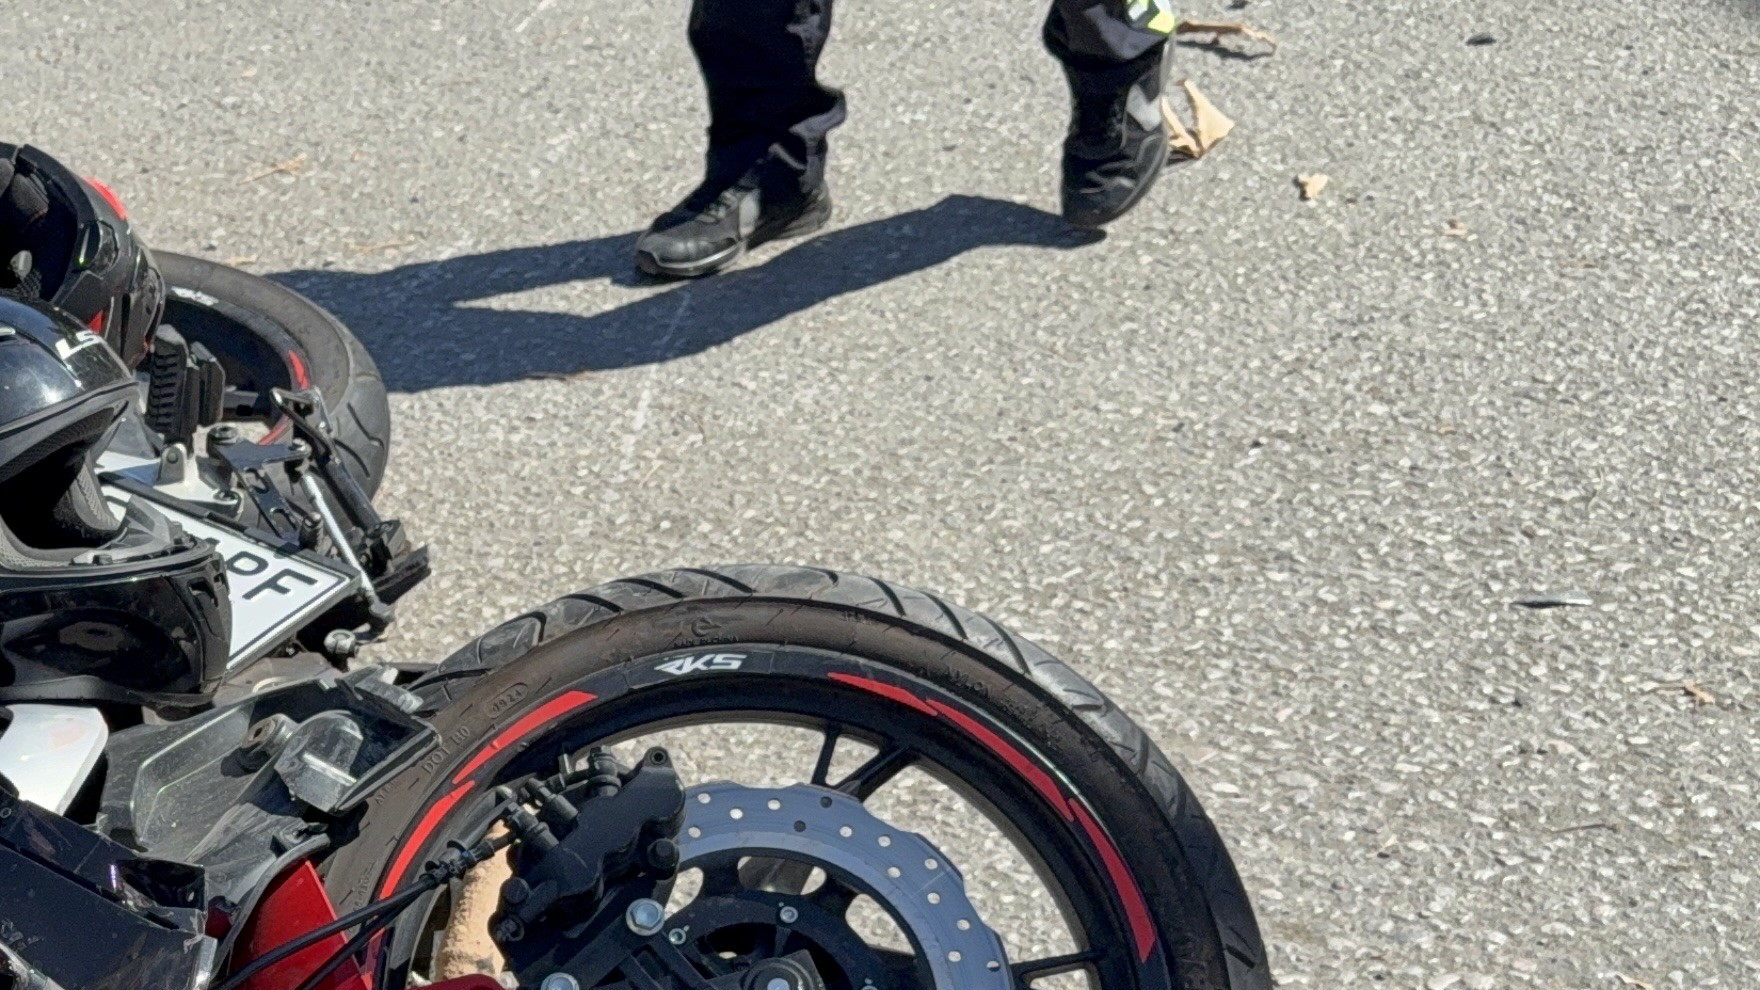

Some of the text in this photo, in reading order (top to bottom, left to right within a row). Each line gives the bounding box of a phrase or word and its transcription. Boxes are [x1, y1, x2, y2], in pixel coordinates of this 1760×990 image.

[206, 538, 319, 600] PF
[654, 653, 747, 675] RKS
[421, 744, 451, 775] DOT
